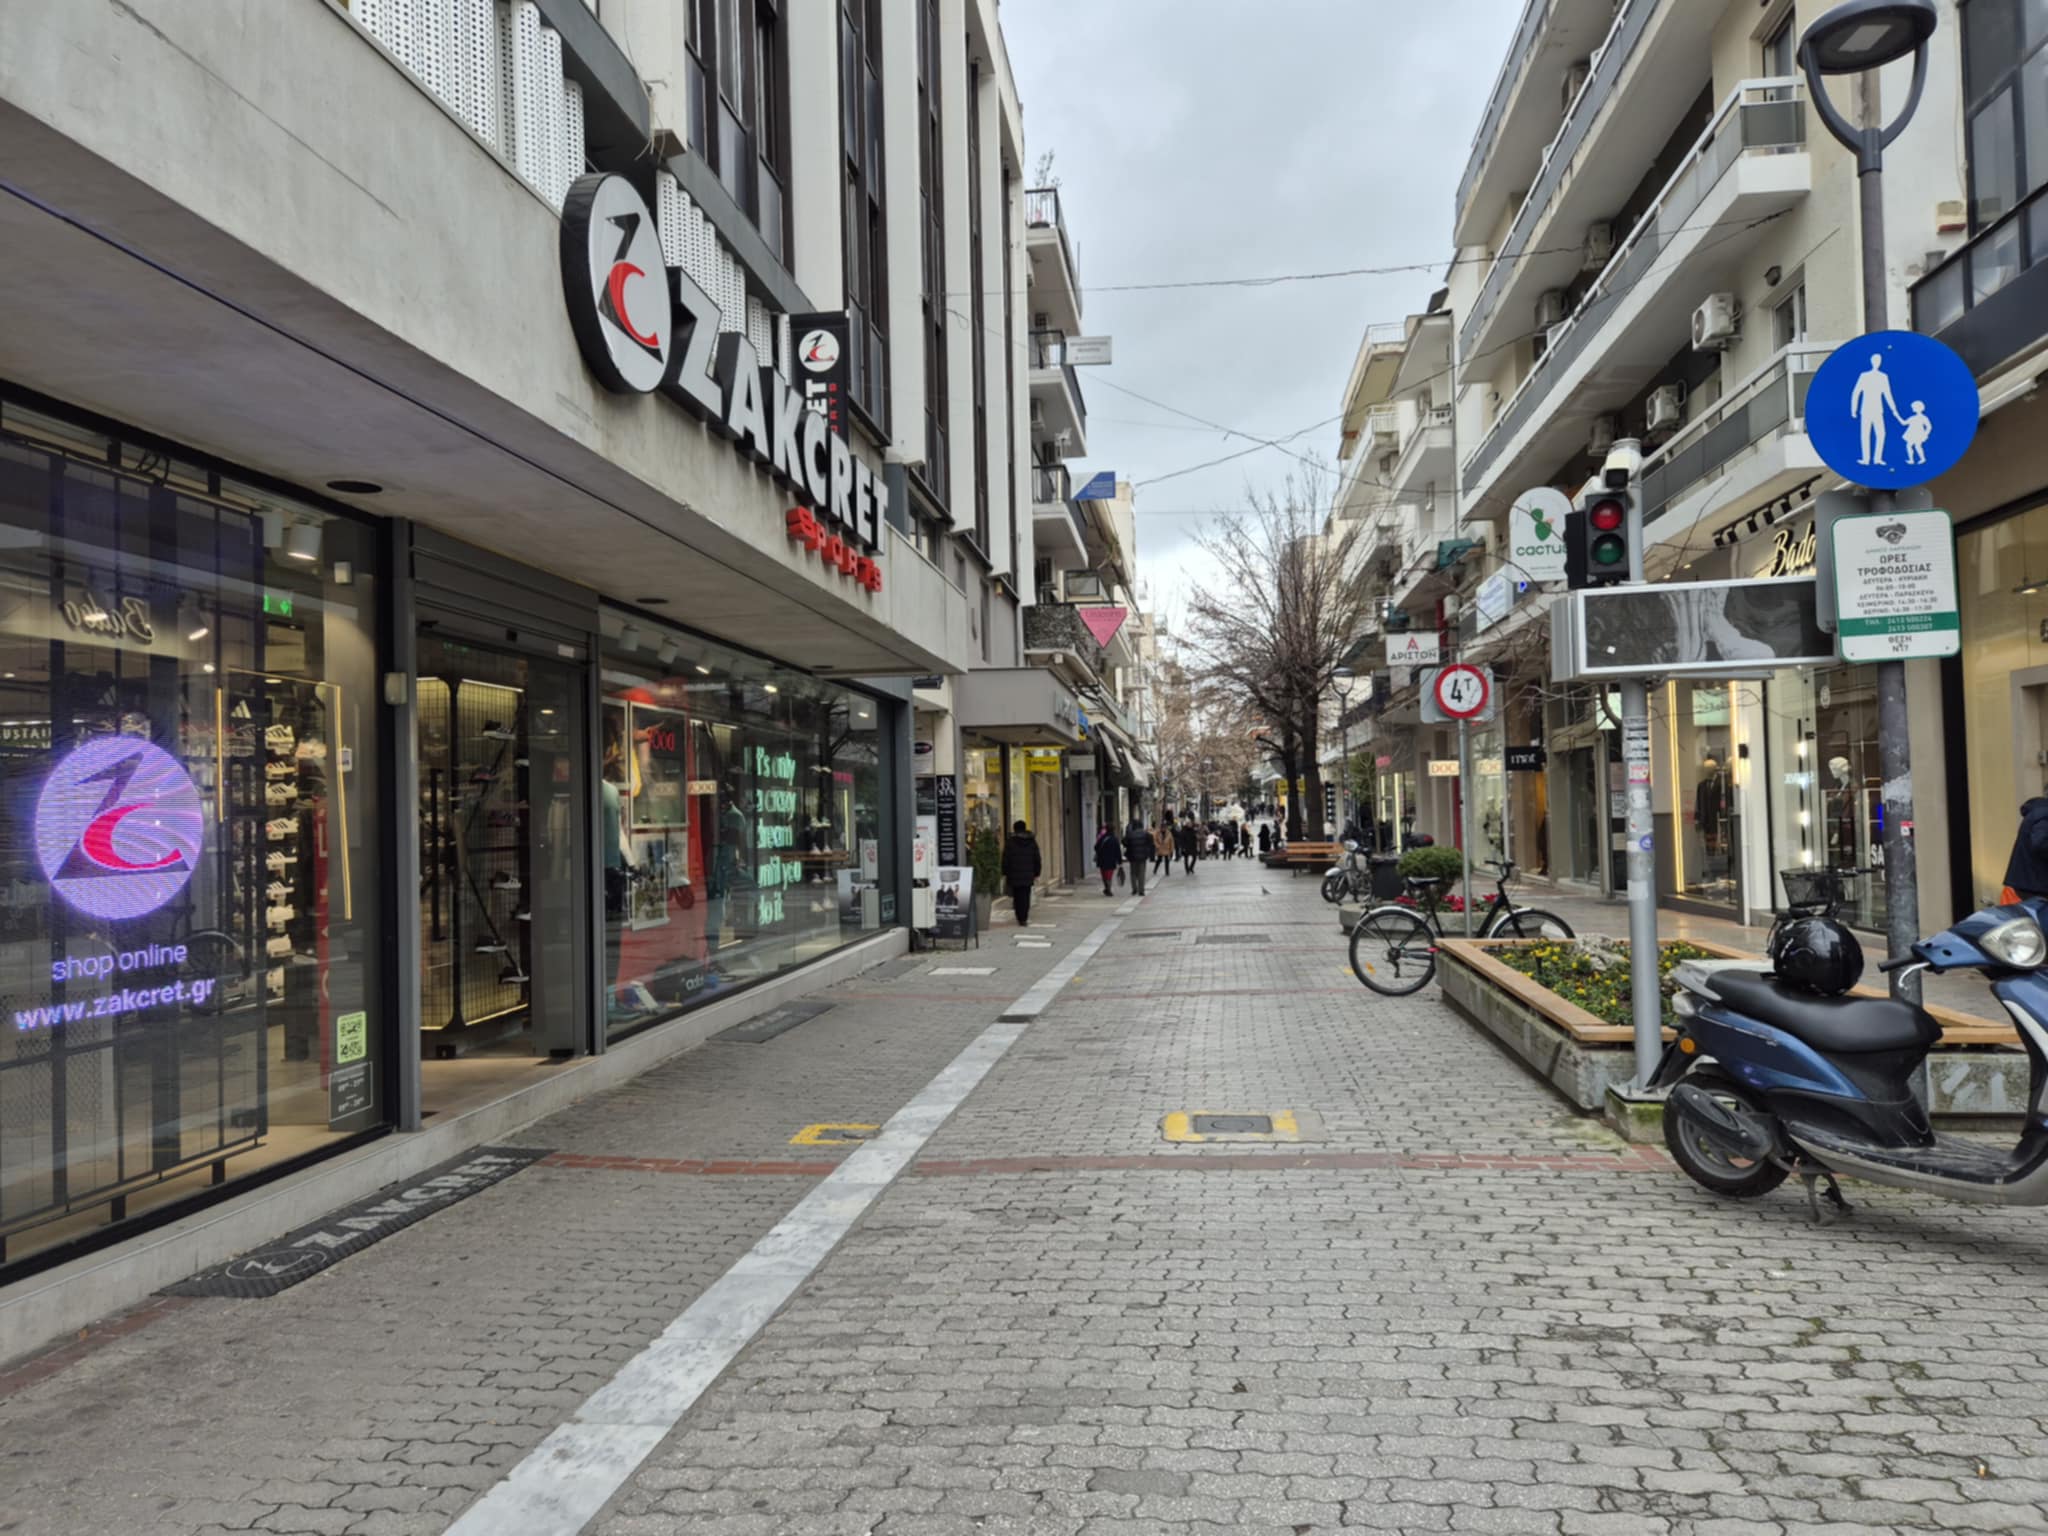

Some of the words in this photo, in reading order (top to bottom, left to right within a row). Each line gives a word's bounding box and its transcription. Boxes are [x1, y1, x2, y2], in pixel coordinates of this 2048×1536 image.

[678, 267, 888, 555] ZAKCRET
[786, 506, 882, 592] SPORTS
[1769, 520, 1817, 577] Bado
[1857, 563, 1932, 577] ΤΡΟΦΟΔΟΣΙΑΣ
[1880, 553, 1907, 563] ΩΡΕΣ
[1888, 635, 1912, 644] ΘΕΣΗ
[1431, 760, 1459, 775] DOC
[51, 953, 113, 982] shop
[119, 943, 188, 971] online
[15, 976, 216, 1031] www.zakcret.gr
[294, 1154, 513, 1250] ZAKCRET
